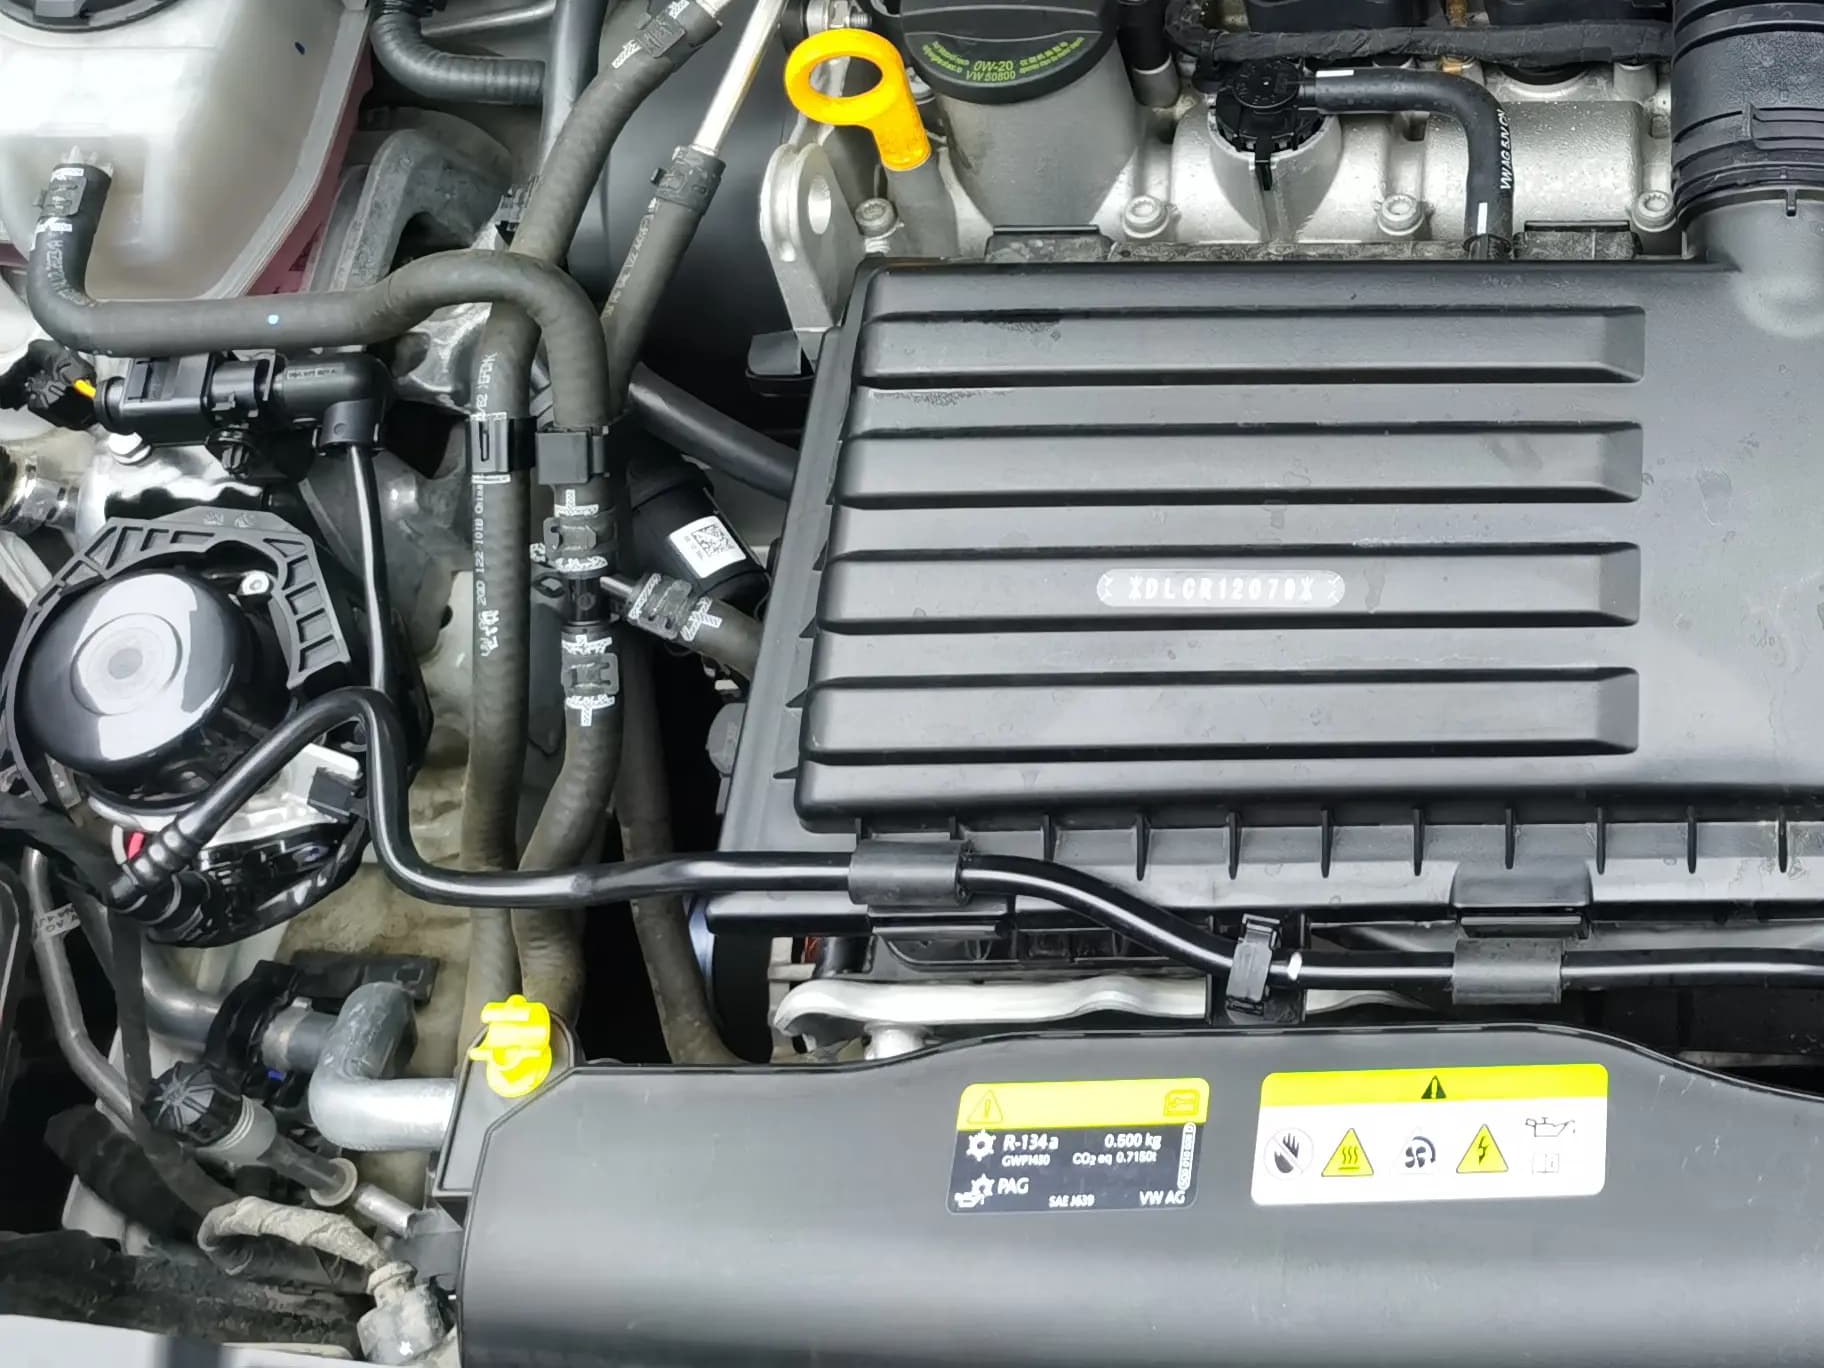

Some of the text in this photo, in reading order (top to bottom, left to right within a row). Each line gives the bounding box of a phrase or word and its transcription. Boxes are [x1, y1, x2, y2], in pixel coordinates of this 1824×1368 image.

[973, 60, 1014, 72] 0W-20
[966, 71, 984, 82] VW
[1145, 1132, 1162, 1150] kg
[997, 1177, 1029, 1194] PAG
[1049, 1195, 1069, 1208] SAE
[1139, 1189, 1186, 1206] VW AG
